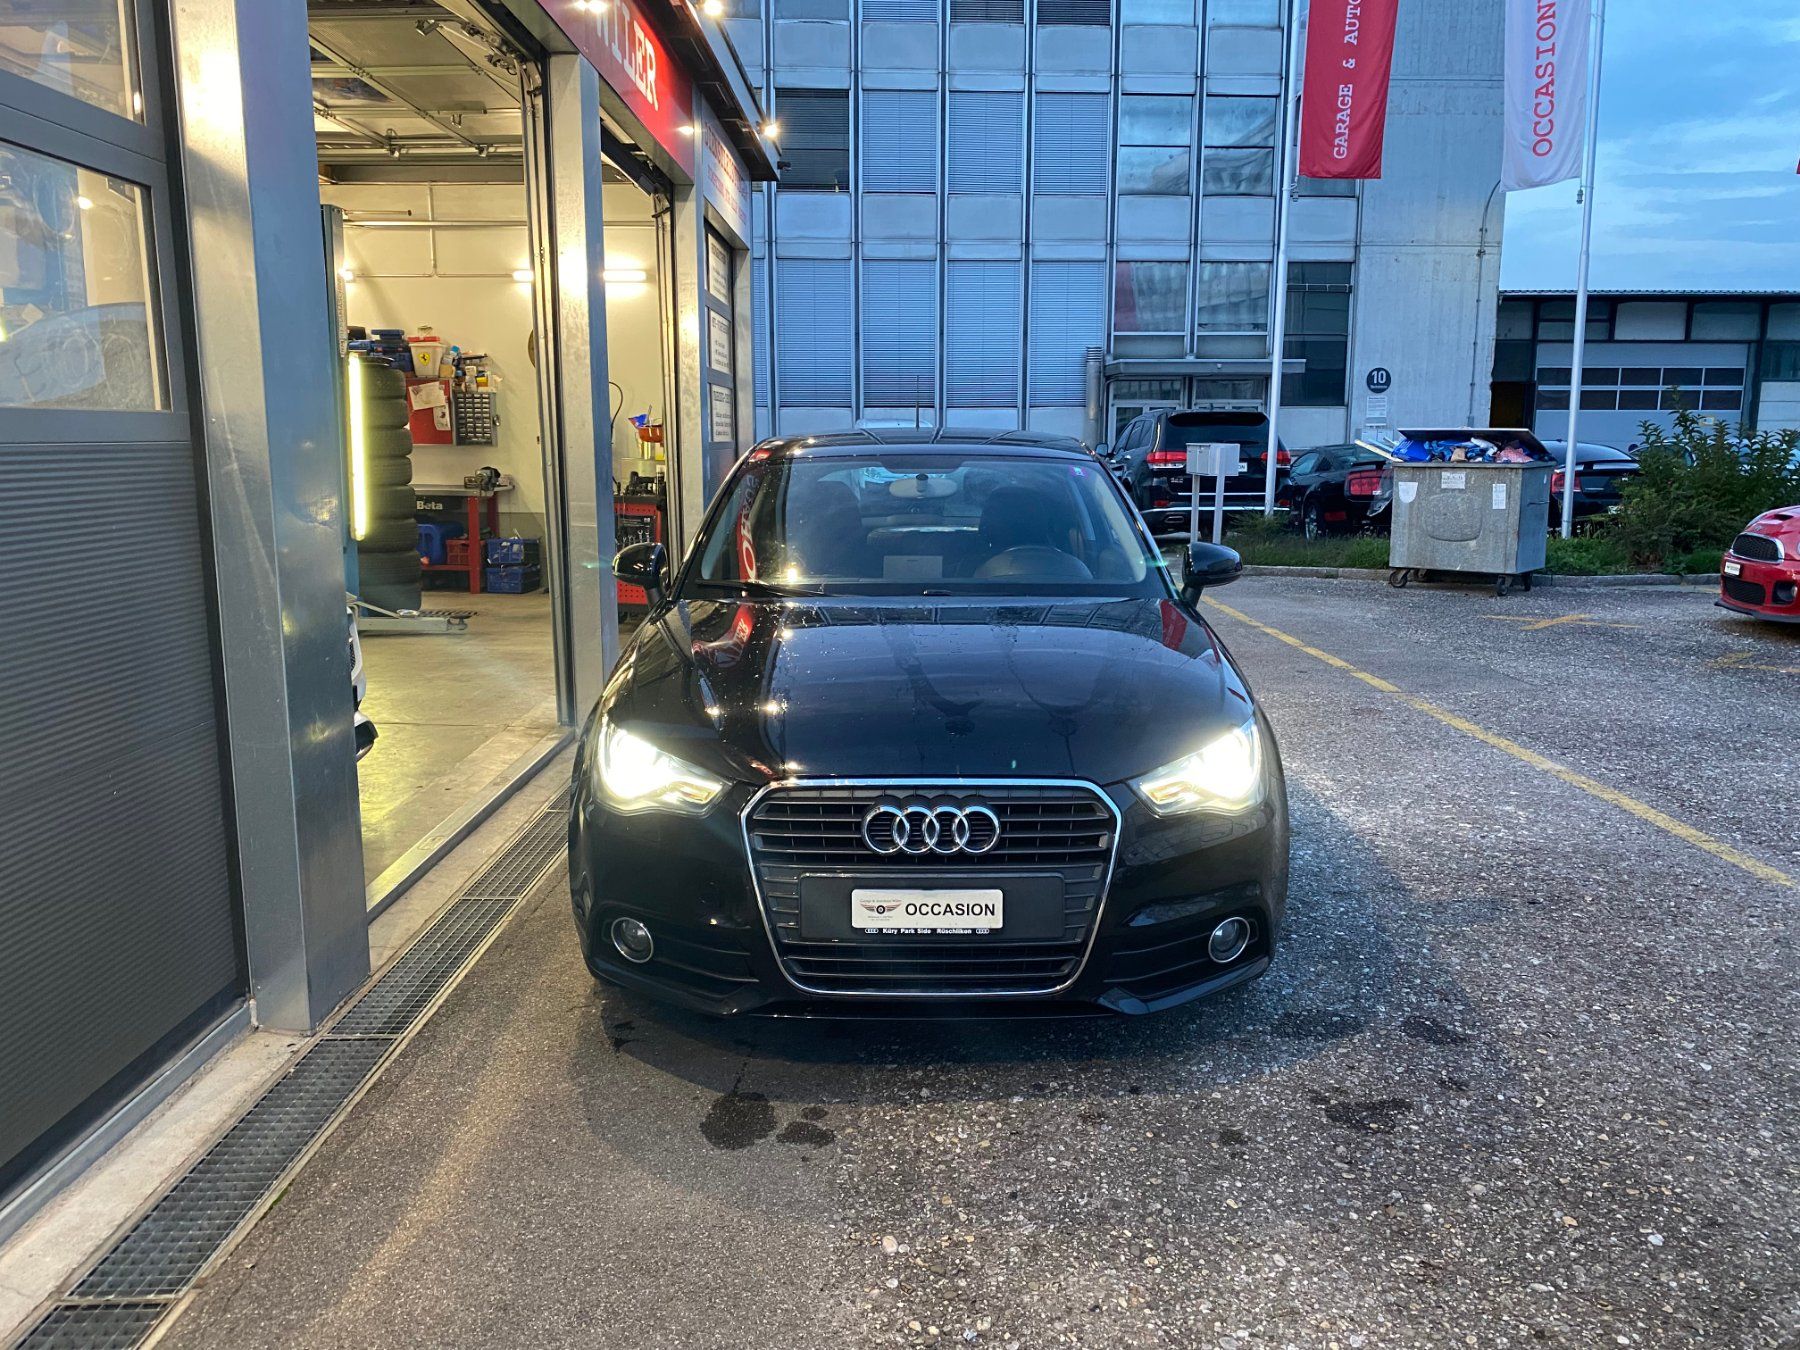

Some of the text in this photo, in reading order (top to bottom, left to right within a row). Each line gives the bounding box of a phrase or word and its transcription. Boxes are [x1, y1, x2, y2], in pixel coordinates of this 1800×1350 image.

[1532, 0, 1556, 157] OCCASION
[1333, 84, 1353, 159] GARAGE
[1343, 58, 1356, 69] &
[1371, 370, 1387, 384] 10
[416, 500, 443, 510] Beta
[905, 903, 995, 916] OCCASION
